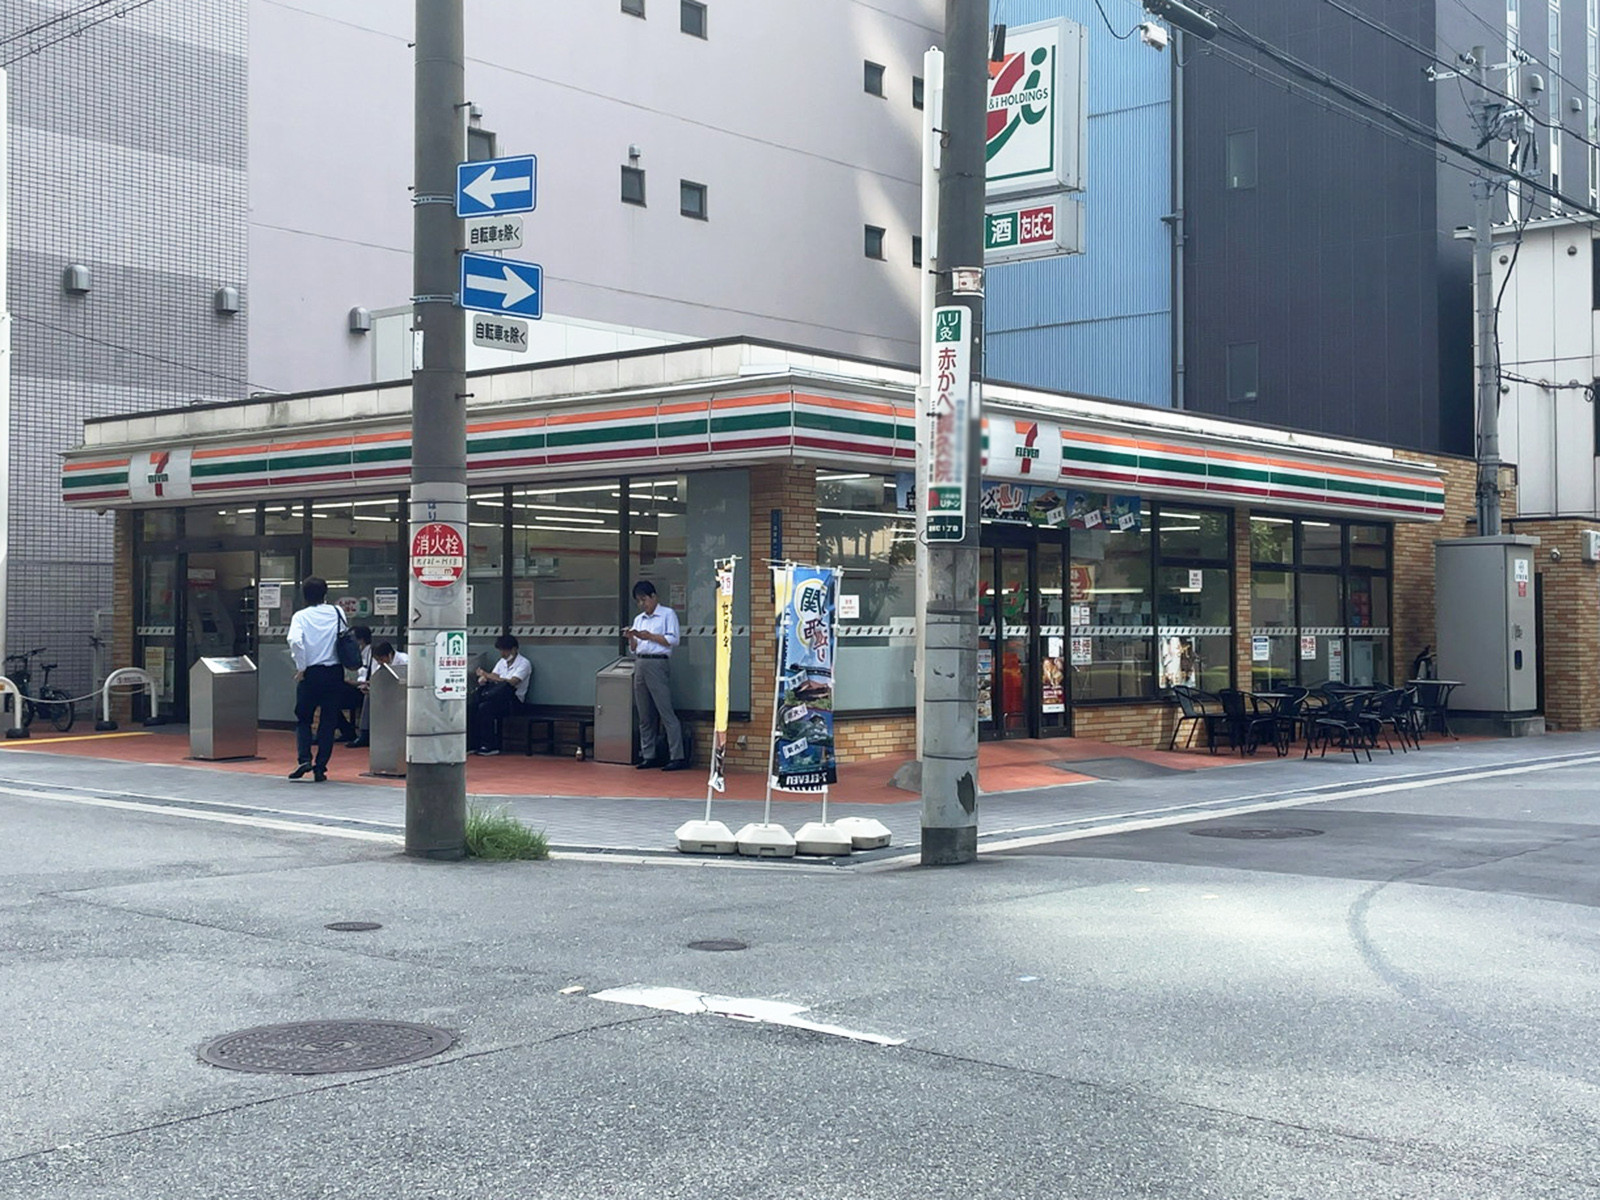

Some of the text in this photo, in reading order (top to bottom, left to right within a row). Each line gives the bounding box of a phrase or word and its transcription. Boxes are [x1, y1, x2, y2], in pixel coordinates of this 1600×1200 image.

[1000, 87, 1048, 107] HOLDINGS
[470, 224, 520, 245] 自転車を除く
[991, 217, 1012, 244] 酒
[1020, 213, 1054, 240] たばこ
[937, 312, 959, 326] ハリ
[475, 322, 527, 346] 自転車を除く
[940, 326, 953, 341] 灸
[940, 498, 960, 509] Uターン
[416, 534, 460, 555] 消火栓
